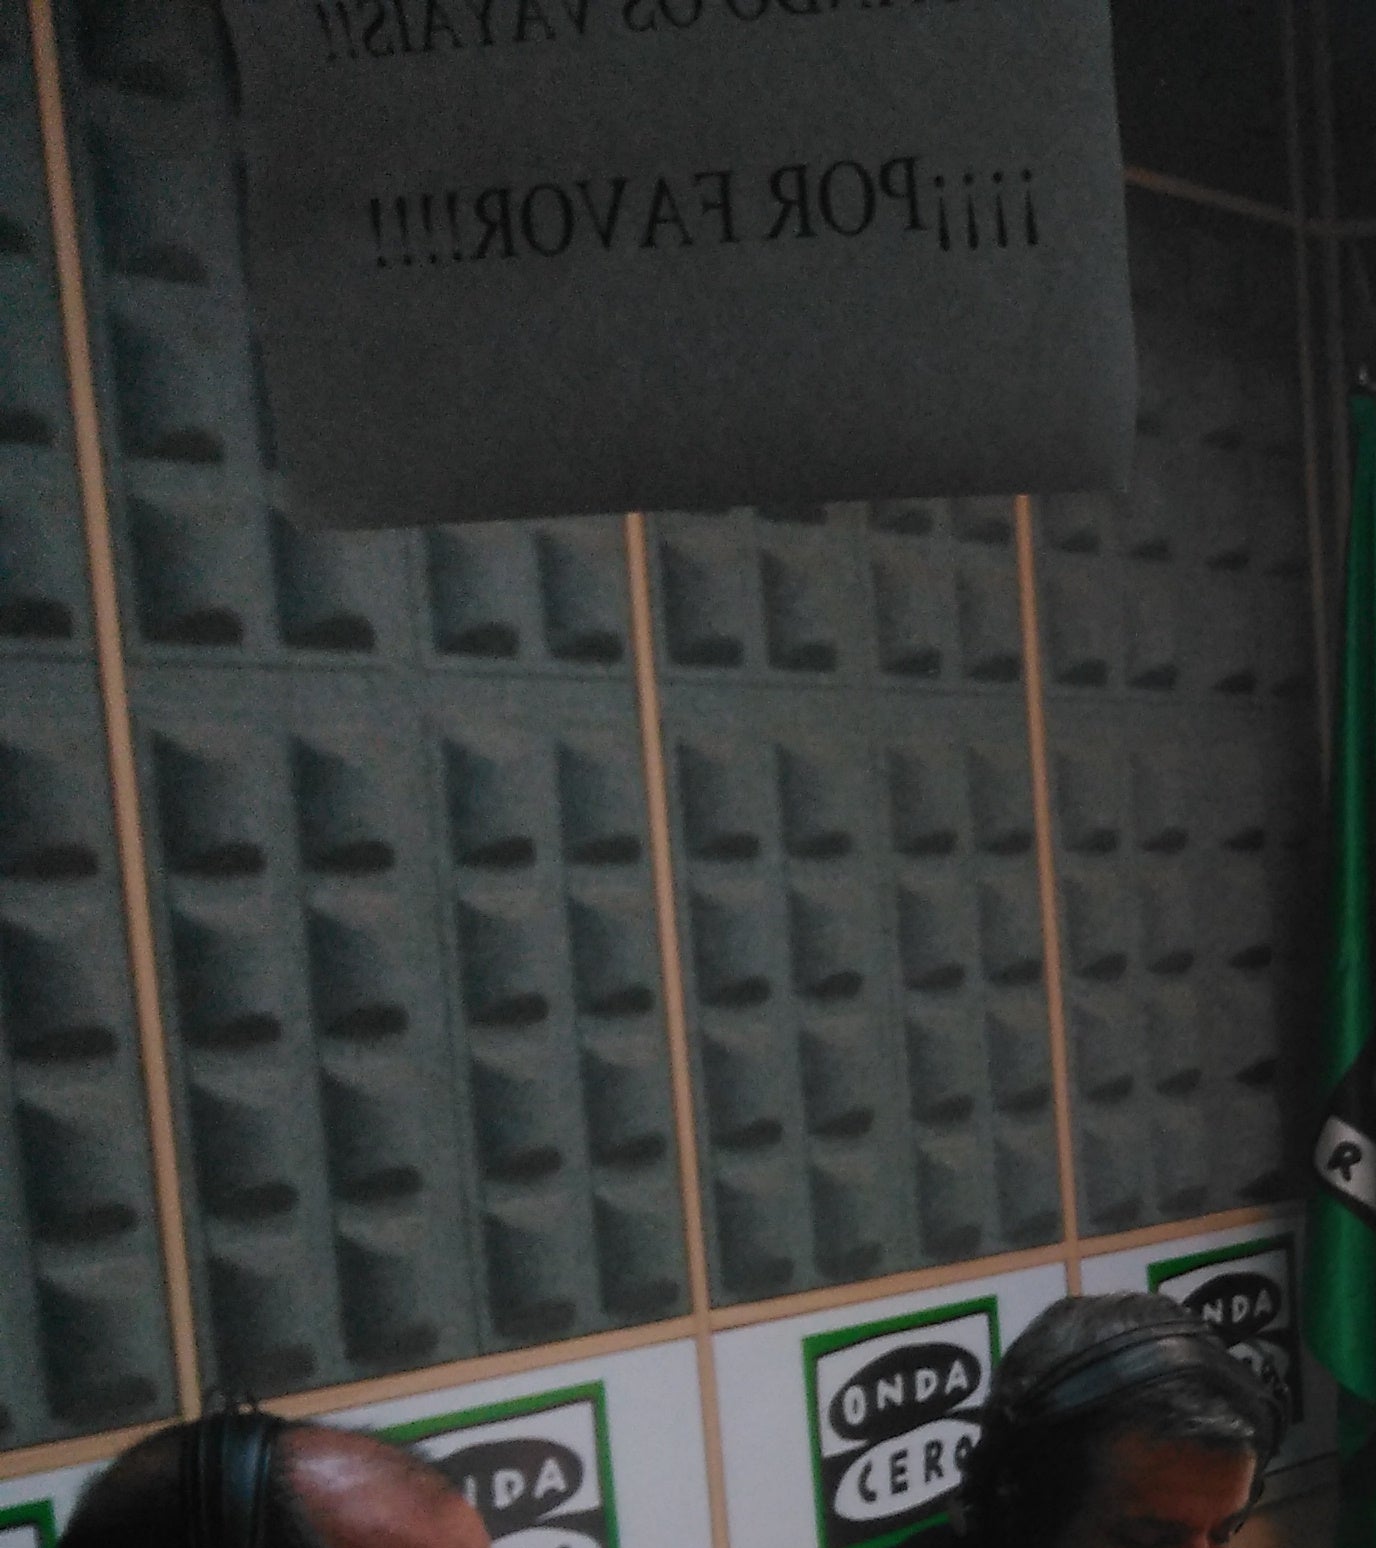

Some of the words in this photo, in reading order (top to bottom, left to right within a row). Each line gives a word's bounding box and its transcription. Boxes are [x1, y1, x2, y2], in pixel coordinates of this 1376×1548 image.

[1202, 1289, 1272, 1323] NDA
[843, 1358, 969, 1426] ONDA
[463, 1456, 568, 1511] DA
[857, 1434, 973, 1503] CERO
